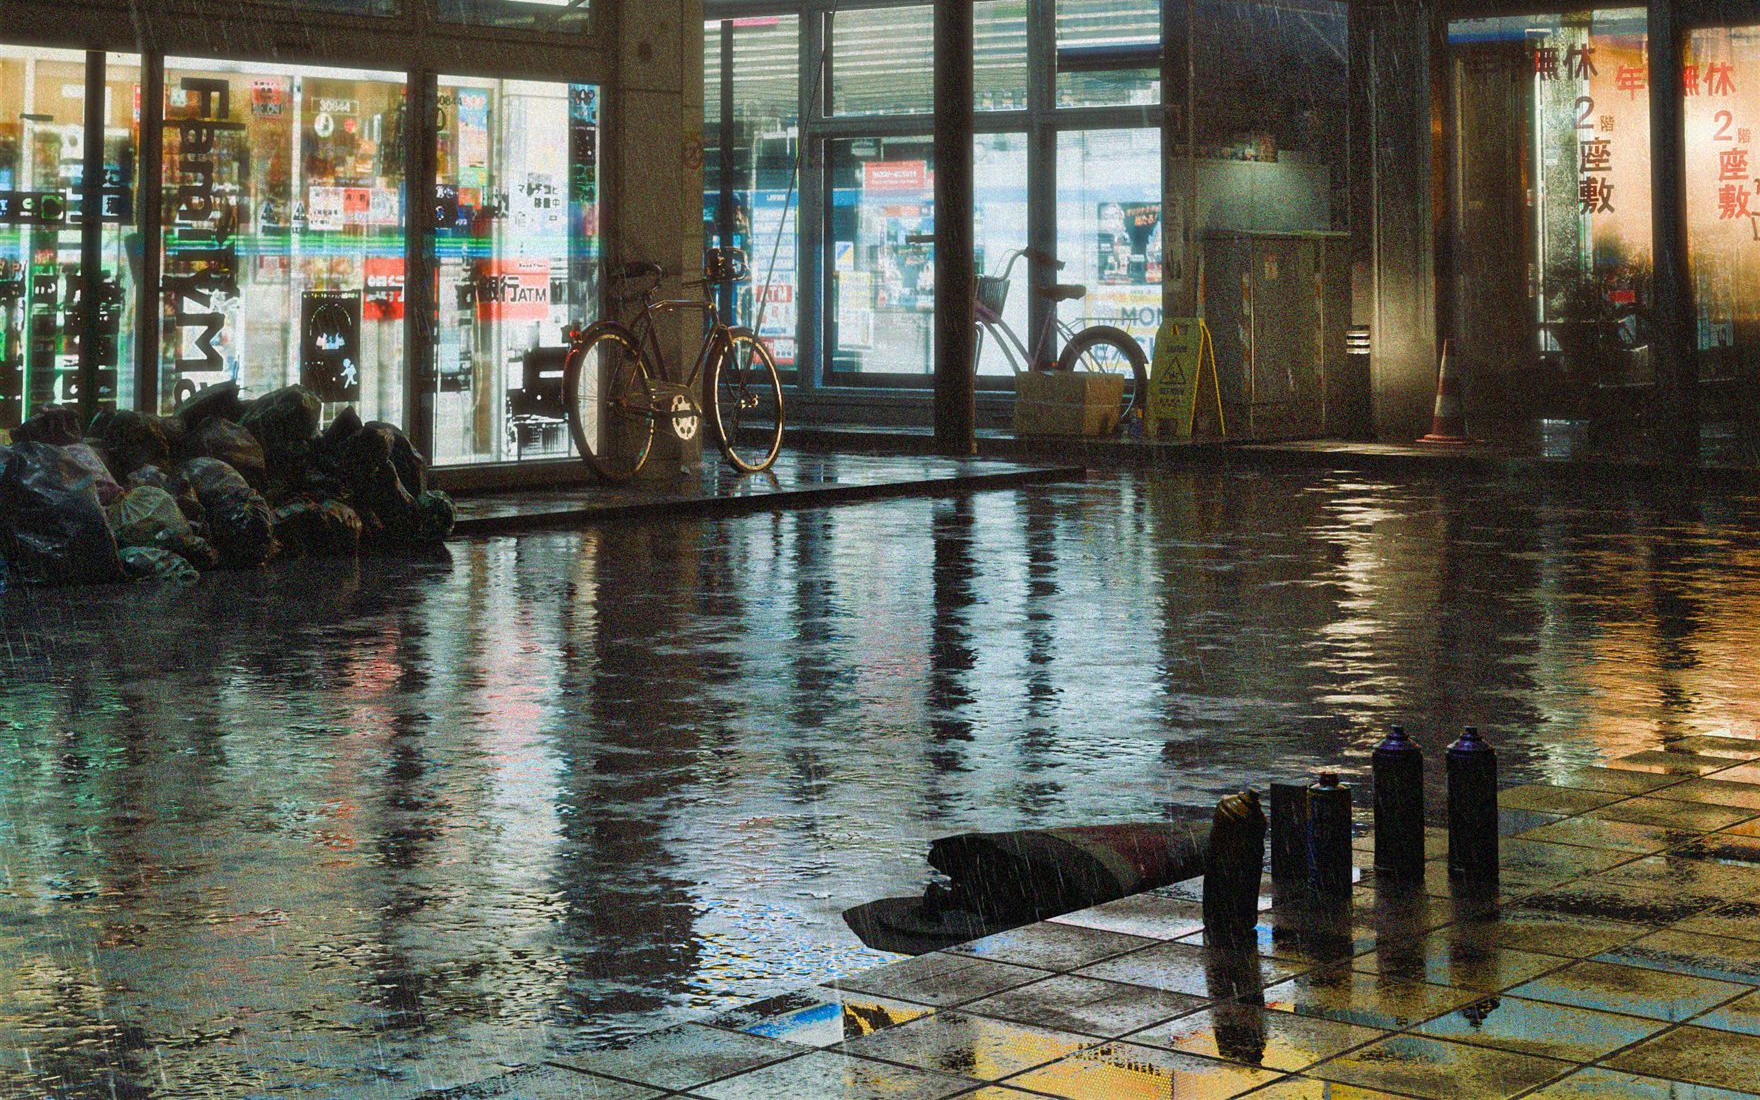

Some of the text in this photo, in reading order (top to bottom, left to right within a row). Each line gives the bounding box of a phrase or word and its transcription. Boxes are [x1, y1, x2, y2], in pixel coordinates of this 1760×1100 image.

[1615, 62, 1737, 100] 年無休
[1717, 146, 1752, 221] 座敷
